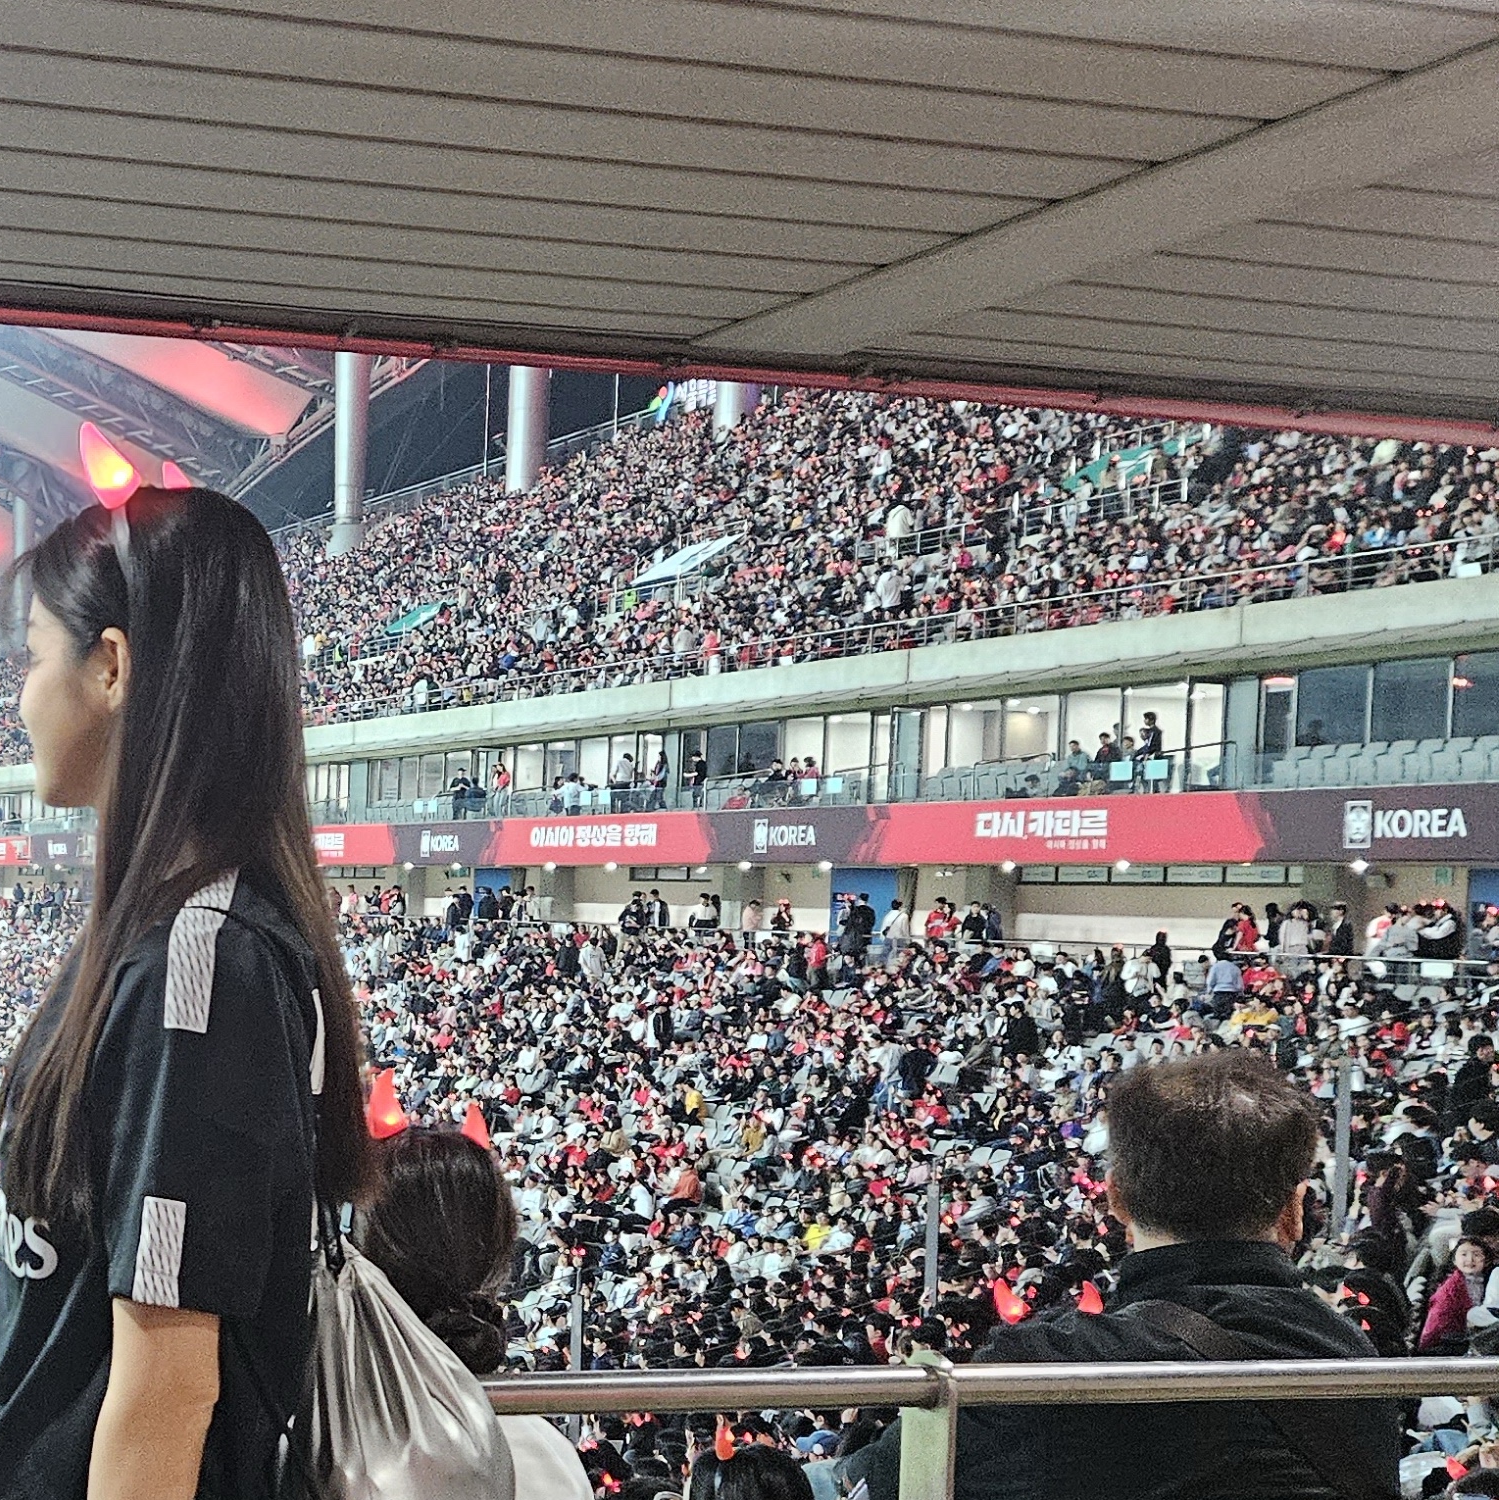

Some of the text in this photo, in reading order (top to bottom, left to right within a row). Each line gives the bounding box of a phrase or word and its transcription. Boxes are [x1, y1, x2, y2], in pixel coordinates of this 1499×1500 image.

[1374, 807, 1468, 838] KOREA
[430, 834, 460, 852] KOREA
[530, 823, 658, 847] 아시아 정상을 향해
[768, 825, 816, 847] KOREA
